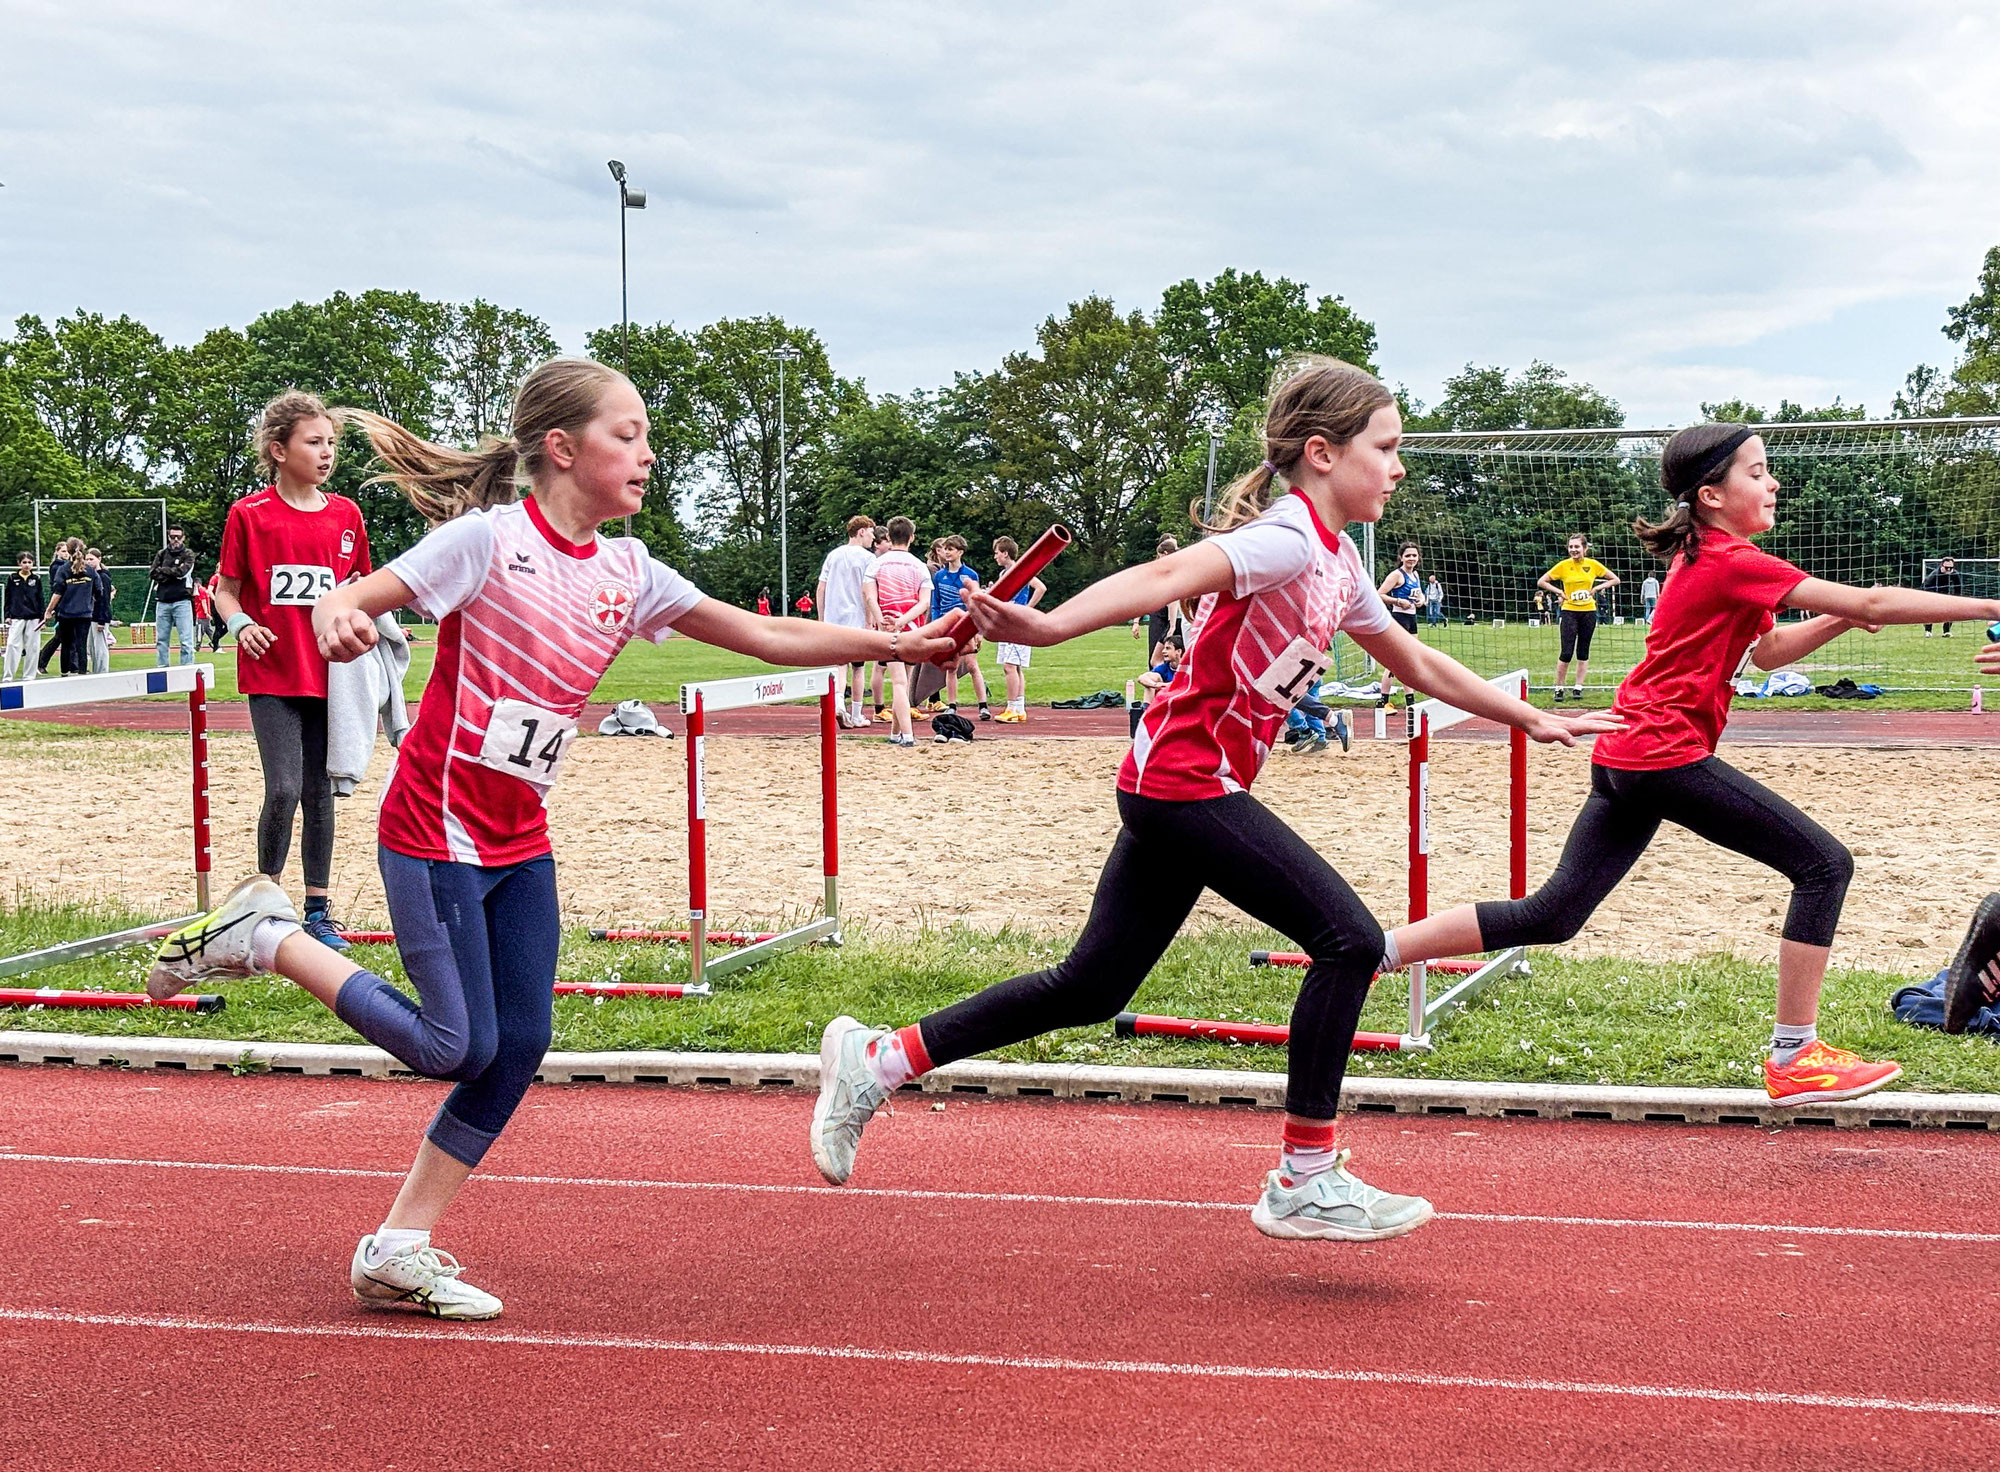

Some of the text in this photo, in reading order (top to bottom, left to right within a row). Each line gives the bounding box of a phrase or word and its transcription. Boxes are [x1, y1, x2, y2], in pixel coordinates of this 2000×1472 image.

[508, 564, 536, 575] erima
[275, 571, 332, 600] 225
[761, 680, 785, 700] polanik
[508, 718, 565, 774] 14
